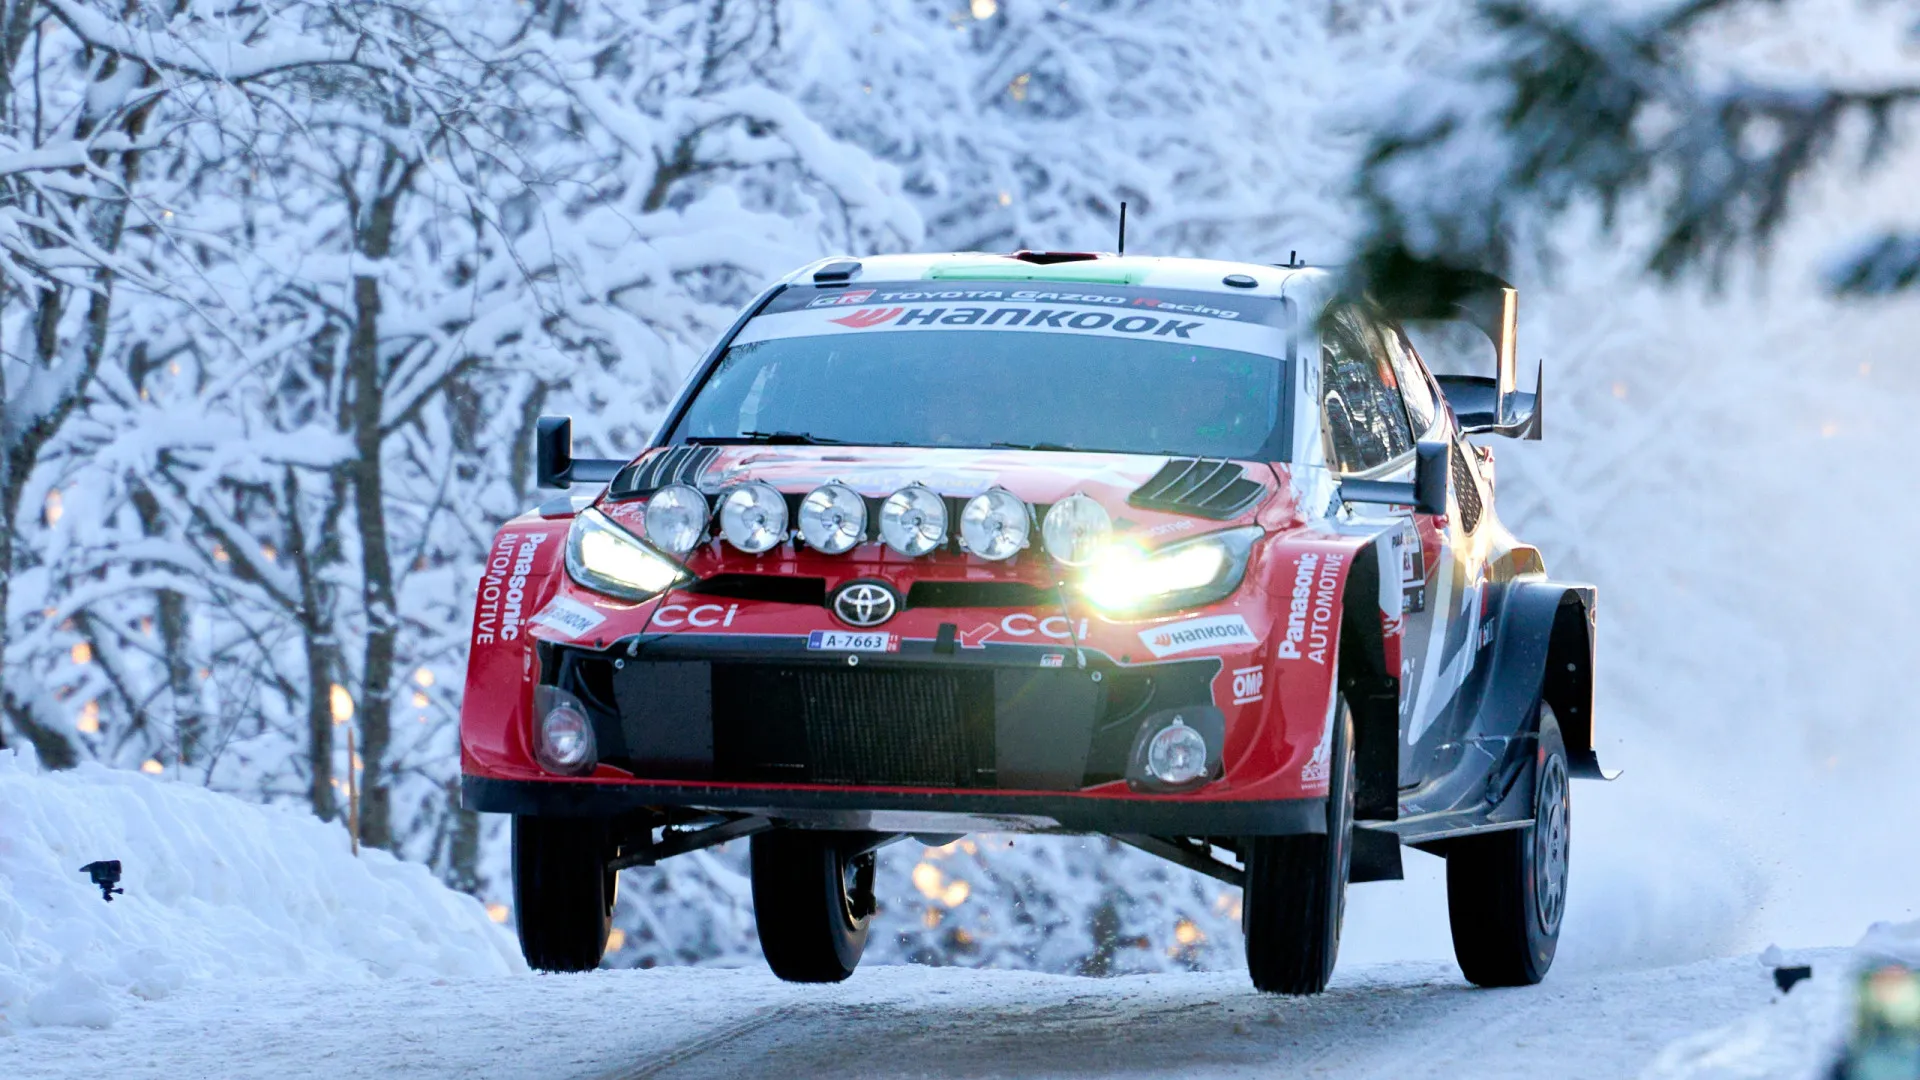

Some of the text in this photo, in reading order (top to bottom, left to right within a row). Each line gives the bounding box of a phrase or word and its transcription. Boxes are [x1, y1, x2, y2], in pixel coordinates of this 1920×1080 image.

[880, 290, 1002, 301] TOYOTA
[1009, 291, 1126, 304] GAZOO
[1133, 298, 1240, 319] Racing
[477, 533, 518, 645] AUTOMOTIVE
[501, 532, 548, 641] Panasonic
[1278, 552, 1319, 660] Panasonic
[1308, 553, 1344, 664] AUTOMOTIVE
[826, 635, 882, 648] A-7663
[1233, 672, 1263, 697] OMP
